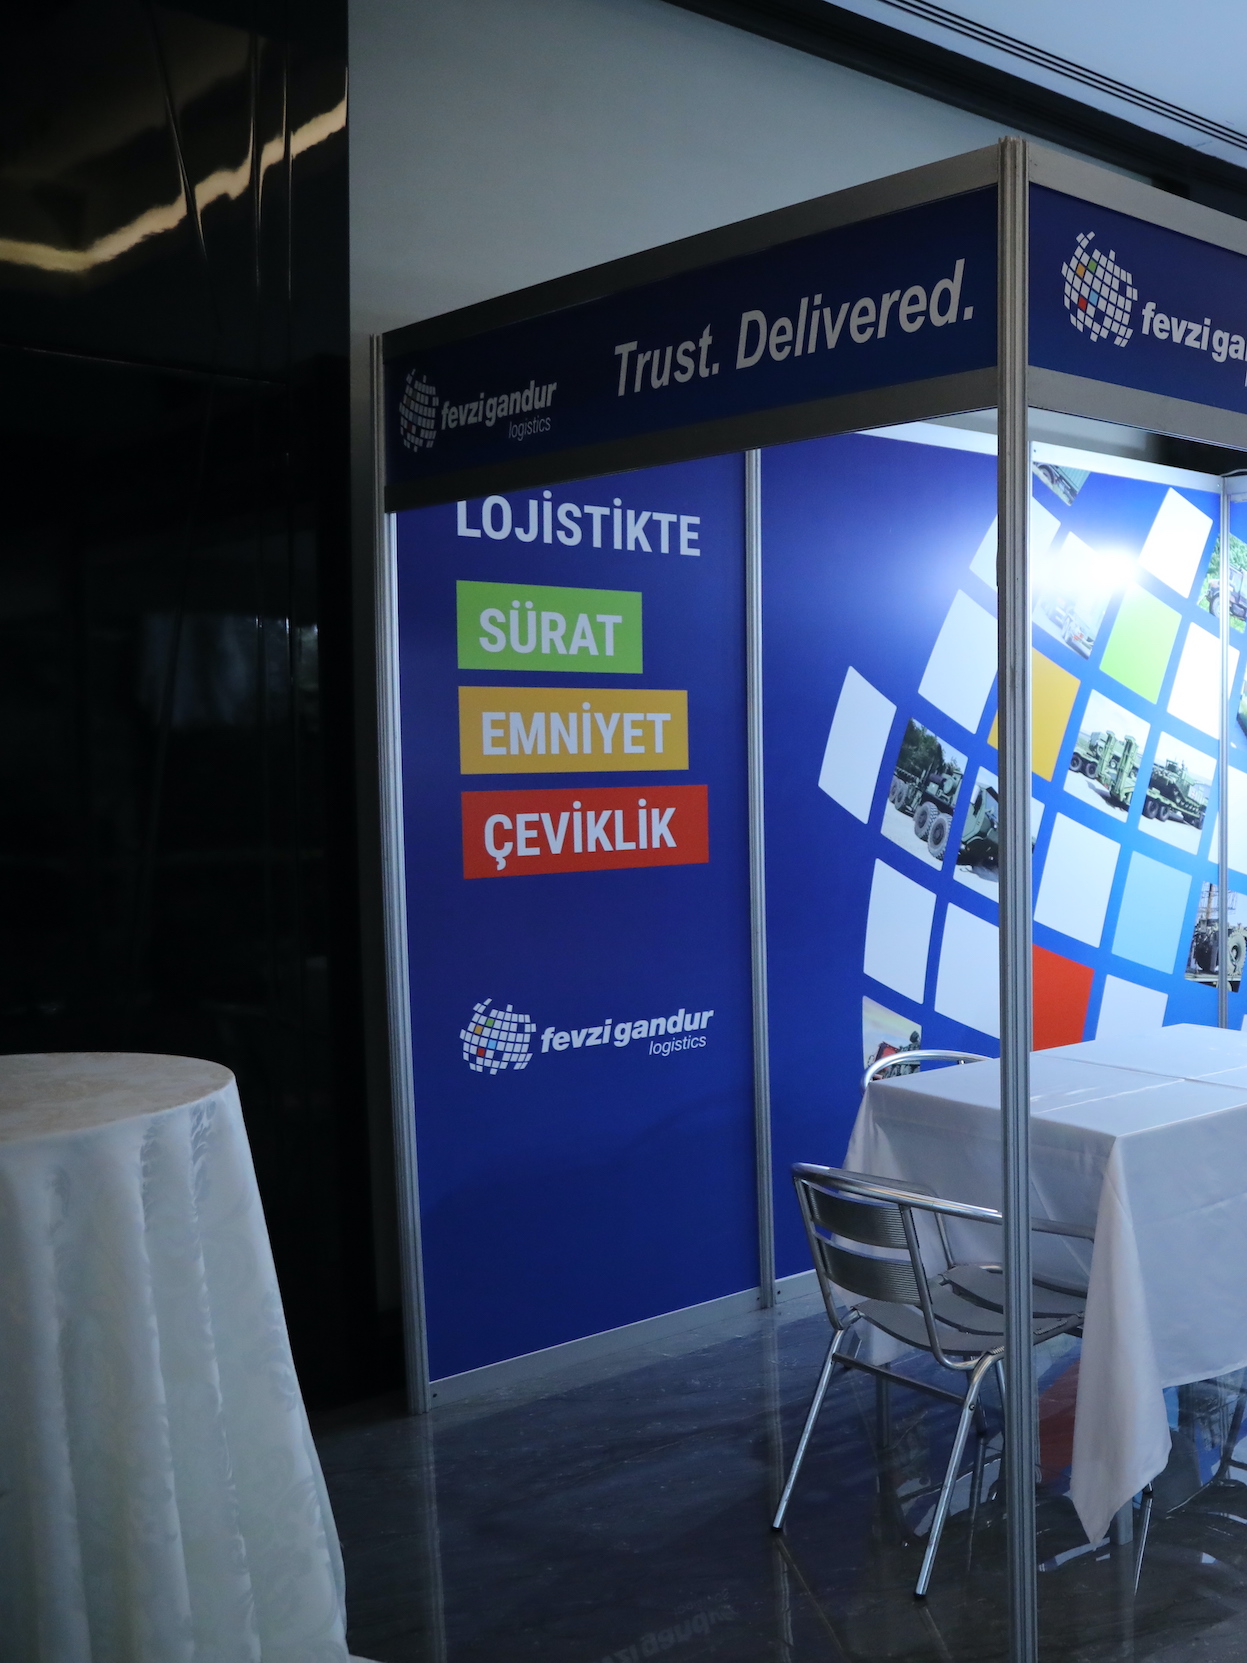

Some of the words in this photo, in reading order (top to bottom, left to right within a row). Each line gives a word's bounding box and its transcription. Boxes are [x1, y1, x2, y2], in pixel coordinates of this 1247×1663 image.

[614, 325, 720, 397] Trust.
[735, 258, 974, 371] Delivered.
[508, 416, 552, 441] logistics
[456, 489, 701, 557] LOJİSTİKTE
[479, 600, 623, 656] SÜRAT
[481, 702, 672, 756] EMNİYET
[484, 799, 677, 871] ÇEVİKLİK
[649, 1034, 707, 1057] logistics
